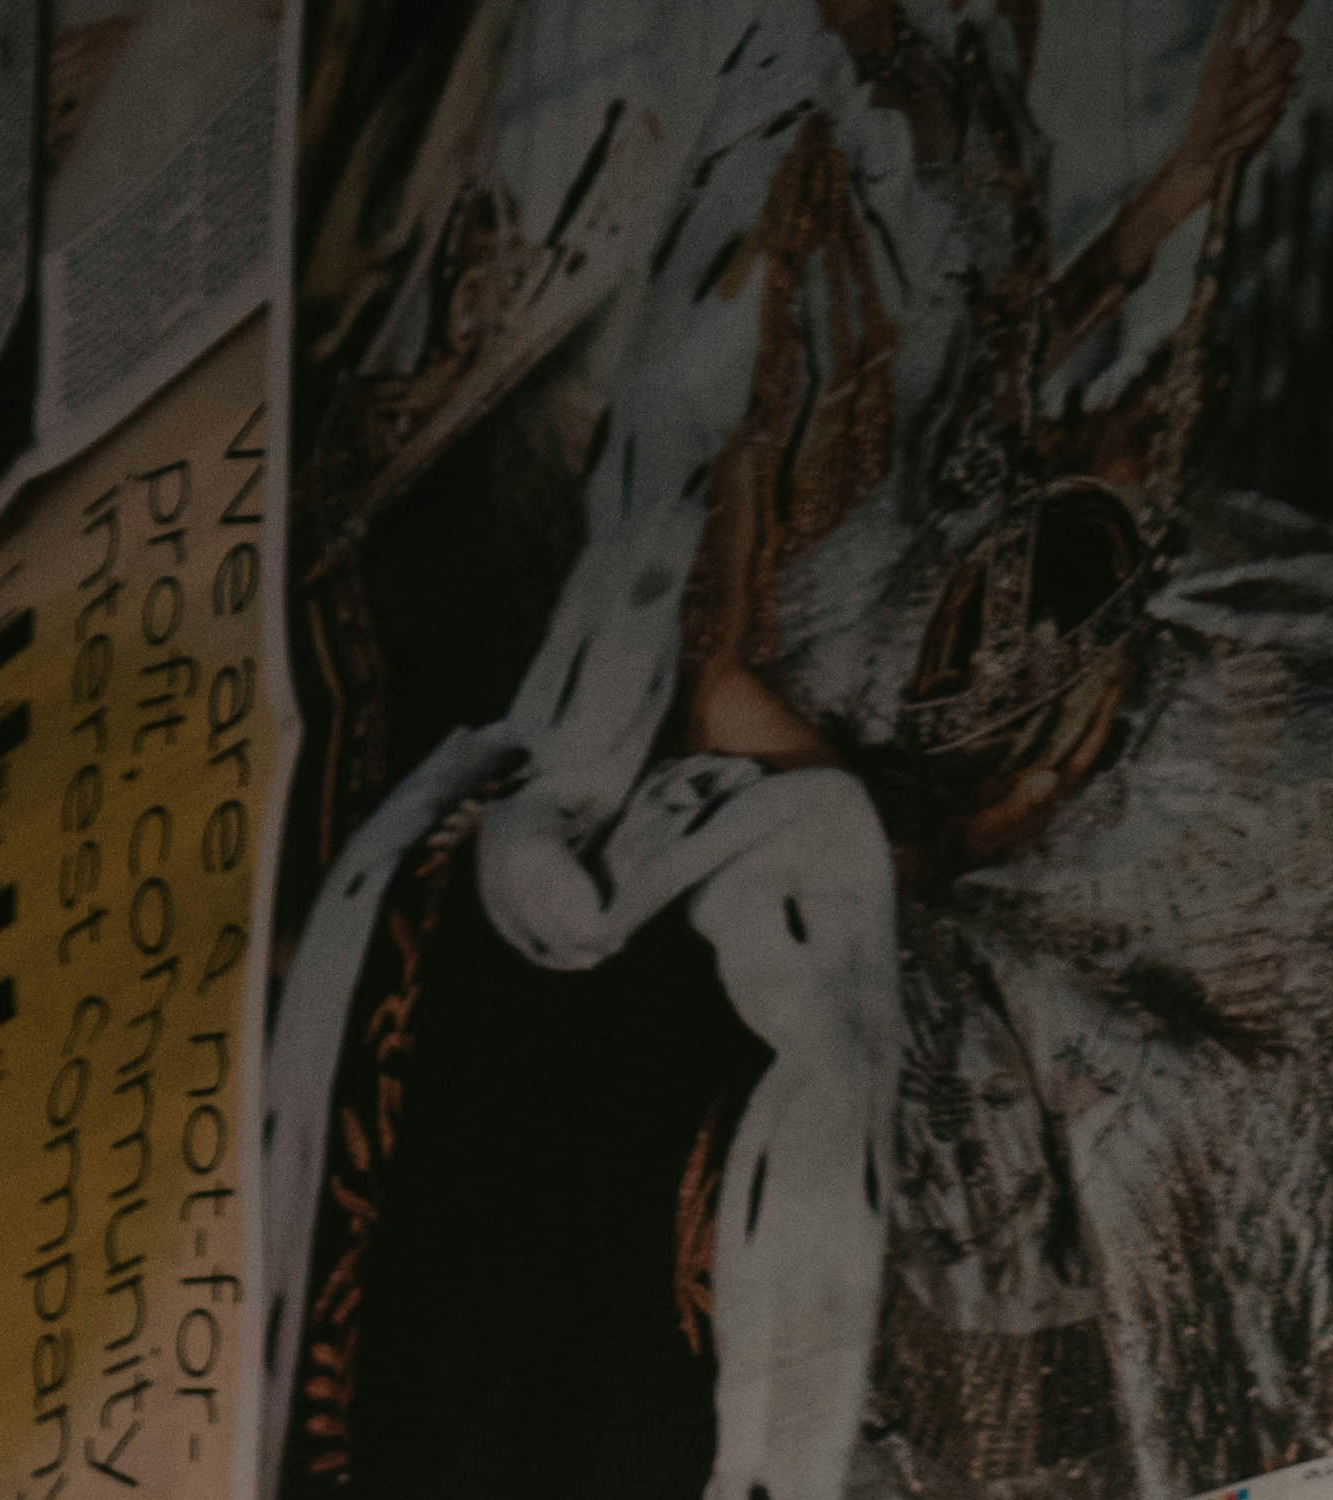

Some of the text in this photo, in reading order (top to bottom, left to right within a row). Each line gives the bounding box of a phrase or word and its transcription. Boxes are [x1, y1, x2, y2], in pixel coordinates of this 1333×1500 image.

[121, 458, 202, 783] profit,
[212, 400, 270, 618] We
[57, 474, 135, 965] interest
[200, 656, 259, 875] are
[84, 803, 181, 1489] community
[174, 1030, 243, 1463] not-for-
